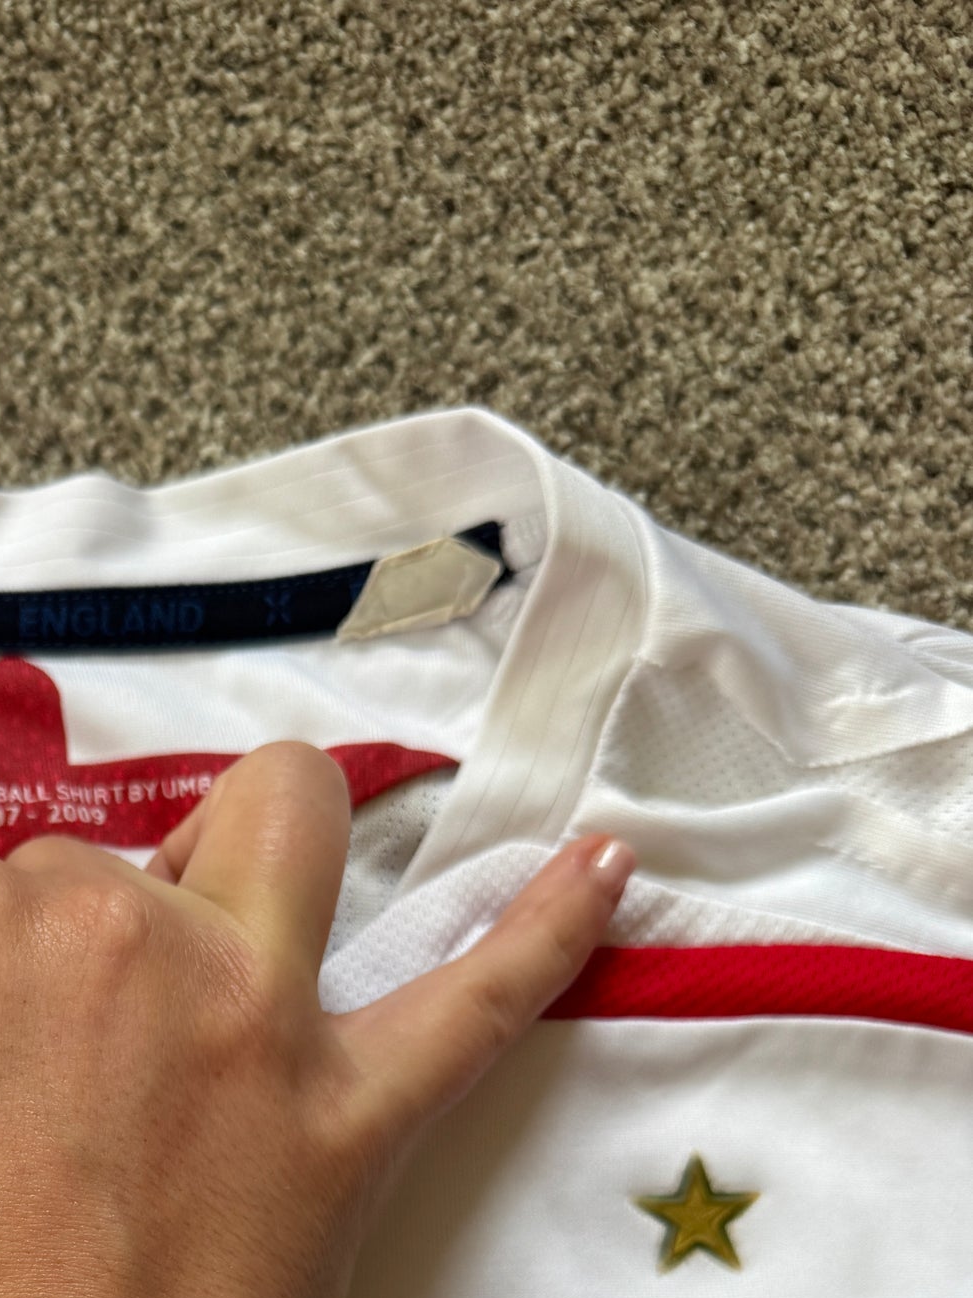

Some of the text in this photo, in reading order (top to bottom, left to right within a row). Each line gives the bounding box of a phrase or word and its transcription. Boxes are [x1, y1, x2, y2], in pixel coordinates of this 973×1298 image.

[18, 600, 205, 638] ENGLAND
[56, 784, 123, 806] SHIRT
[128, 781, 158, 803] BY
[161, 774, 212, 799] UMB
[47, 804, 107, 826] 2009
